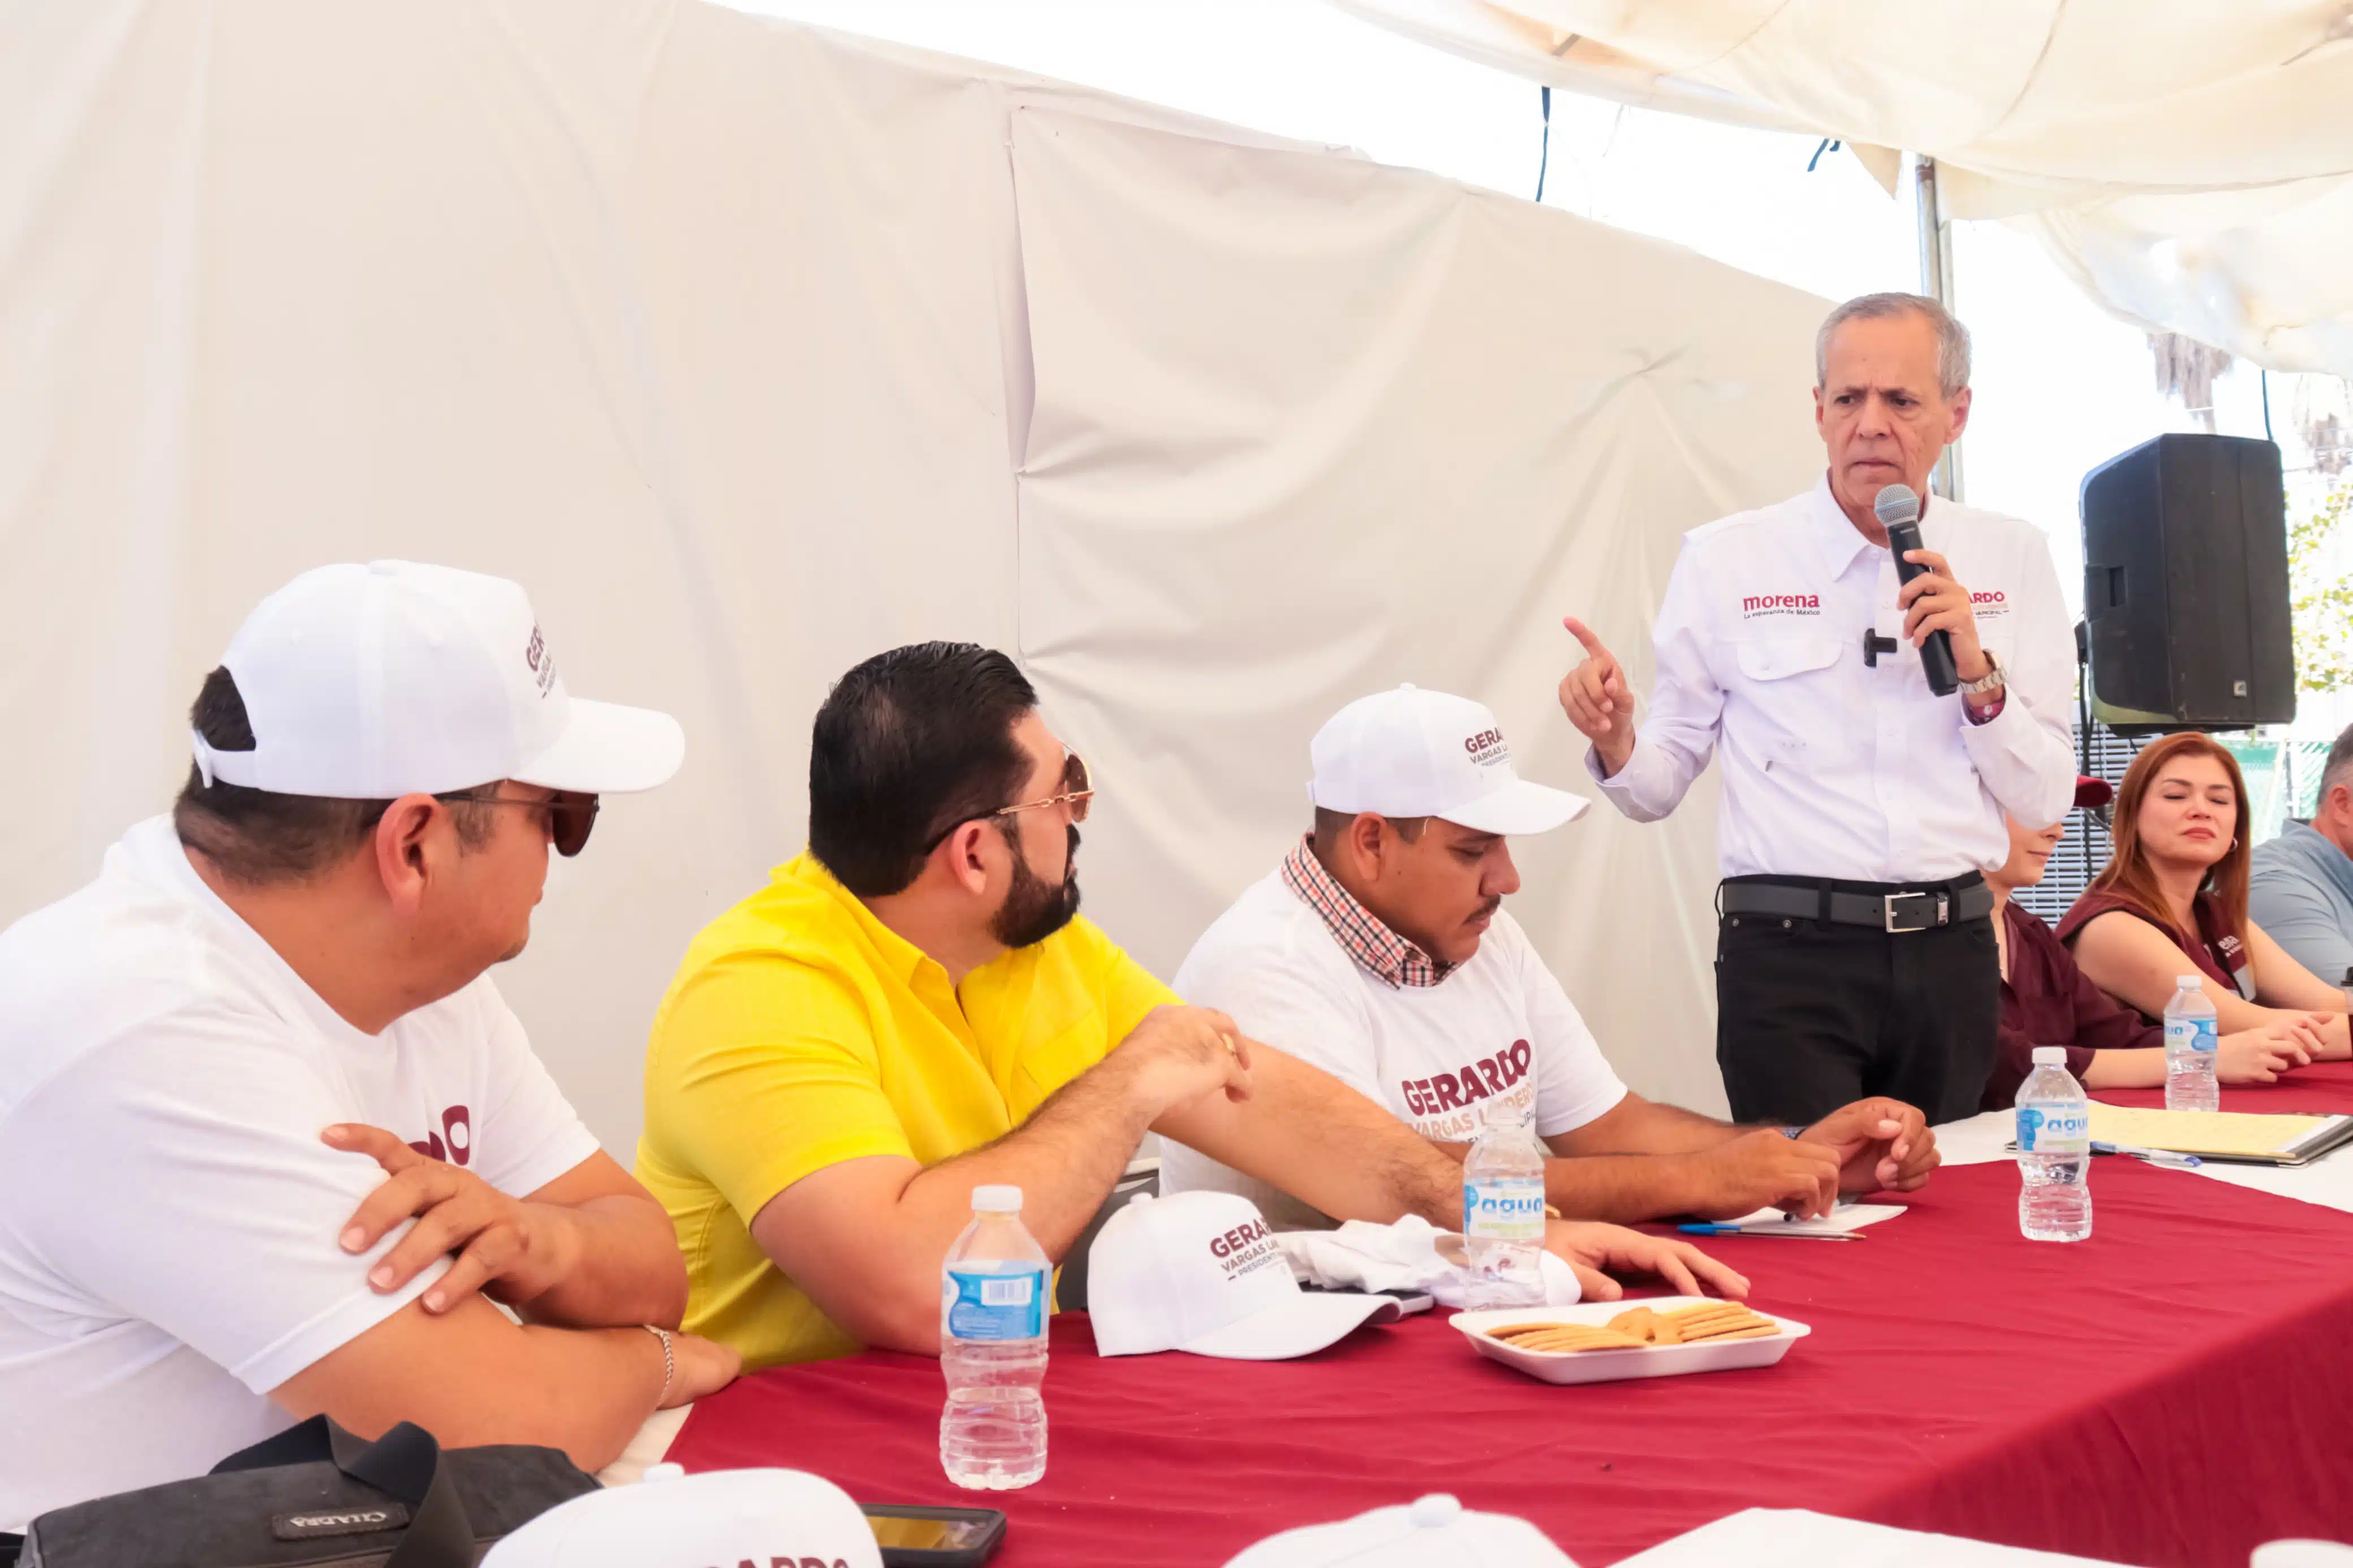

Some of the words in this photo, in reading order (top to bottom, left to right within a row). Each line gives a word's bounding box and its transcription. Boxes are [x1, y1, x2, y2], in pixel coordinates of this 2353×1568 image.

[1743, 594, 1820, 611] morena
[1401, 1039, 1531, 1117] GERARDO
[1221, 1243, 1266, 1272] VARGAS
